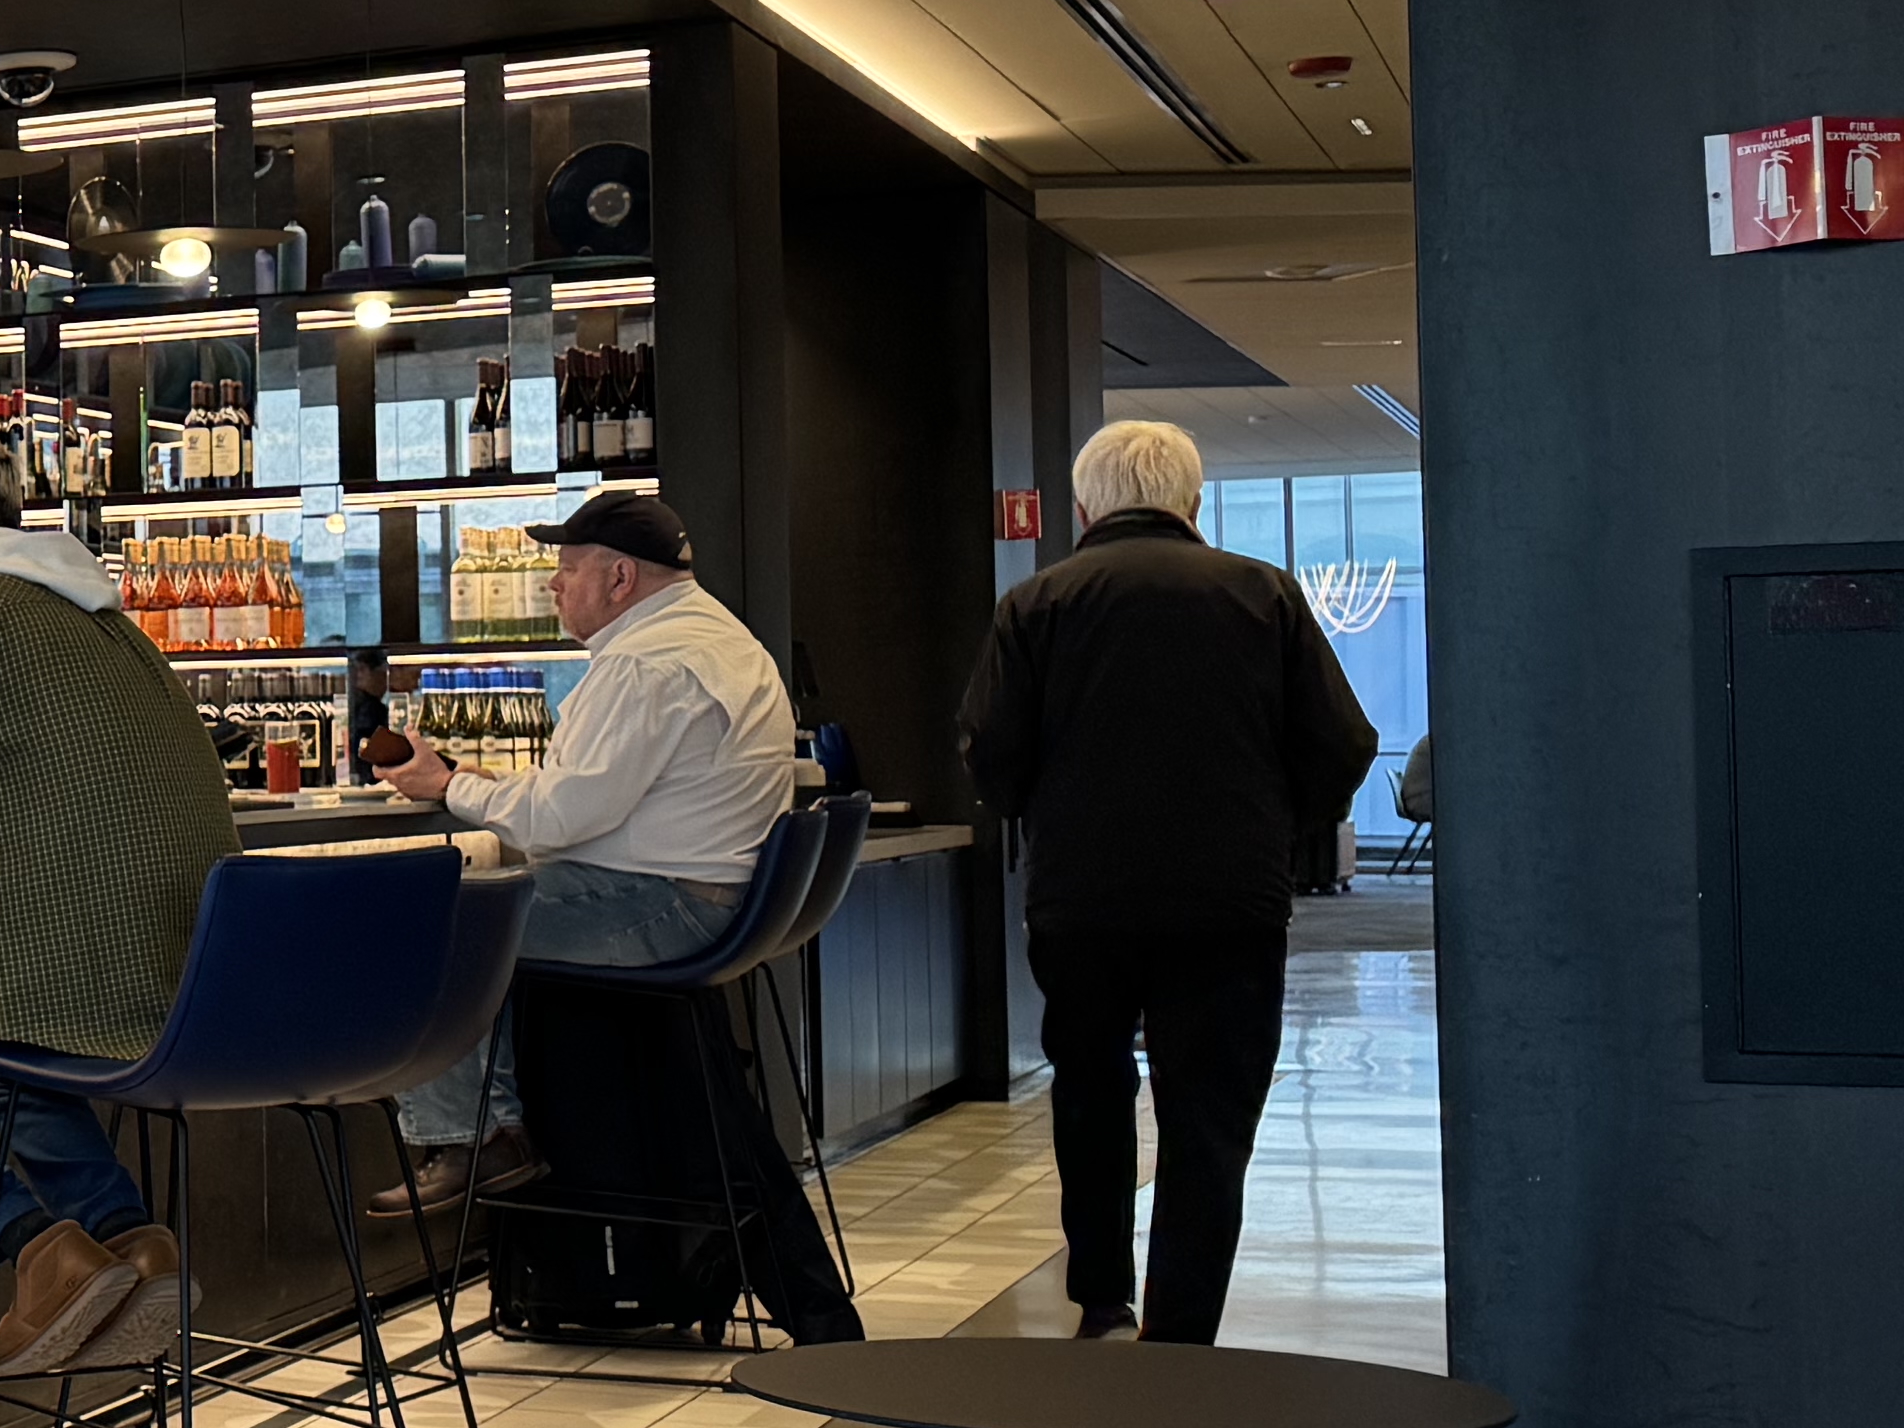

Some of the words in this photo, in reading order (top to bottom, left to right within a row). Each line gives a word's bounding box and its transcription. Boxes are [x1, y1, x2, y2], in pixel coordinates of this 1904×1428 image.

[1848, 121, 1876, 132] FIRE
[1761, 128, 1787, 143] FIRE
[1825, 132, 1901, 142] EXTINGUISHER
[1736, 133, 1812, 157] EXTINGUISHER
